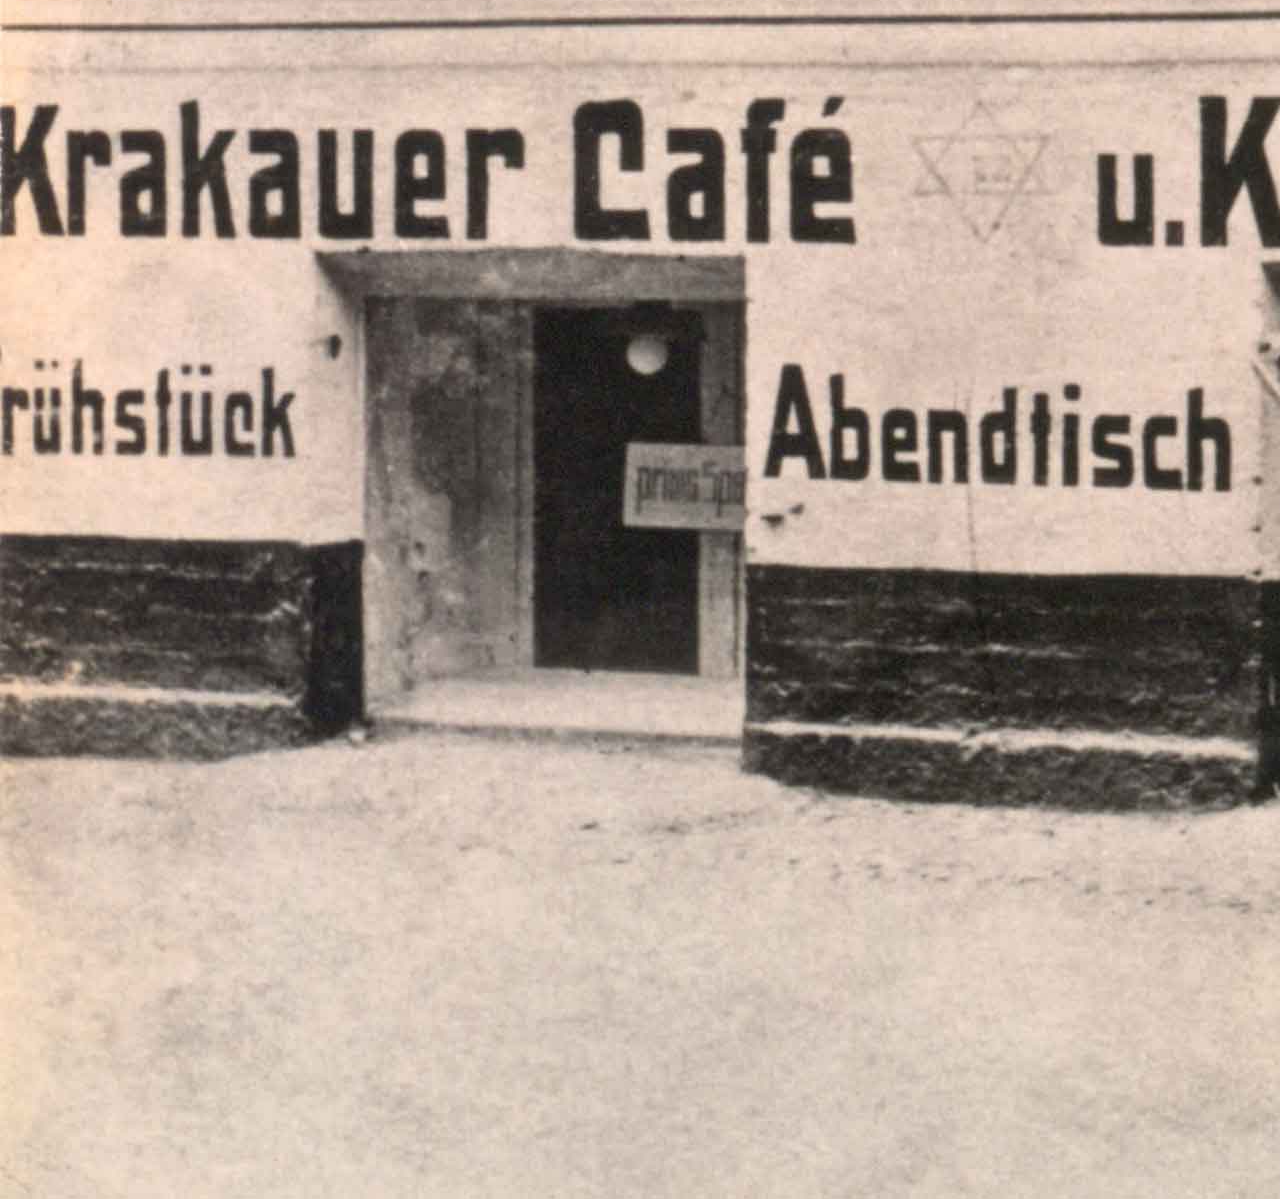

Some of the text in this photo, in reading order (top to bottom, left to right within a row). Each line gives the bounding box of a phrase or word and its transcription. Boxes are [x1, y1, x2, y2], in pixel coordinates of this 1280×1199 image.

[0, 101, 524, 239] Krakauer
[574, 97, 855, 243] Café
[3, 363, 294, 457] rühstück
[765, 365, 1230, 491] Abendtisch
